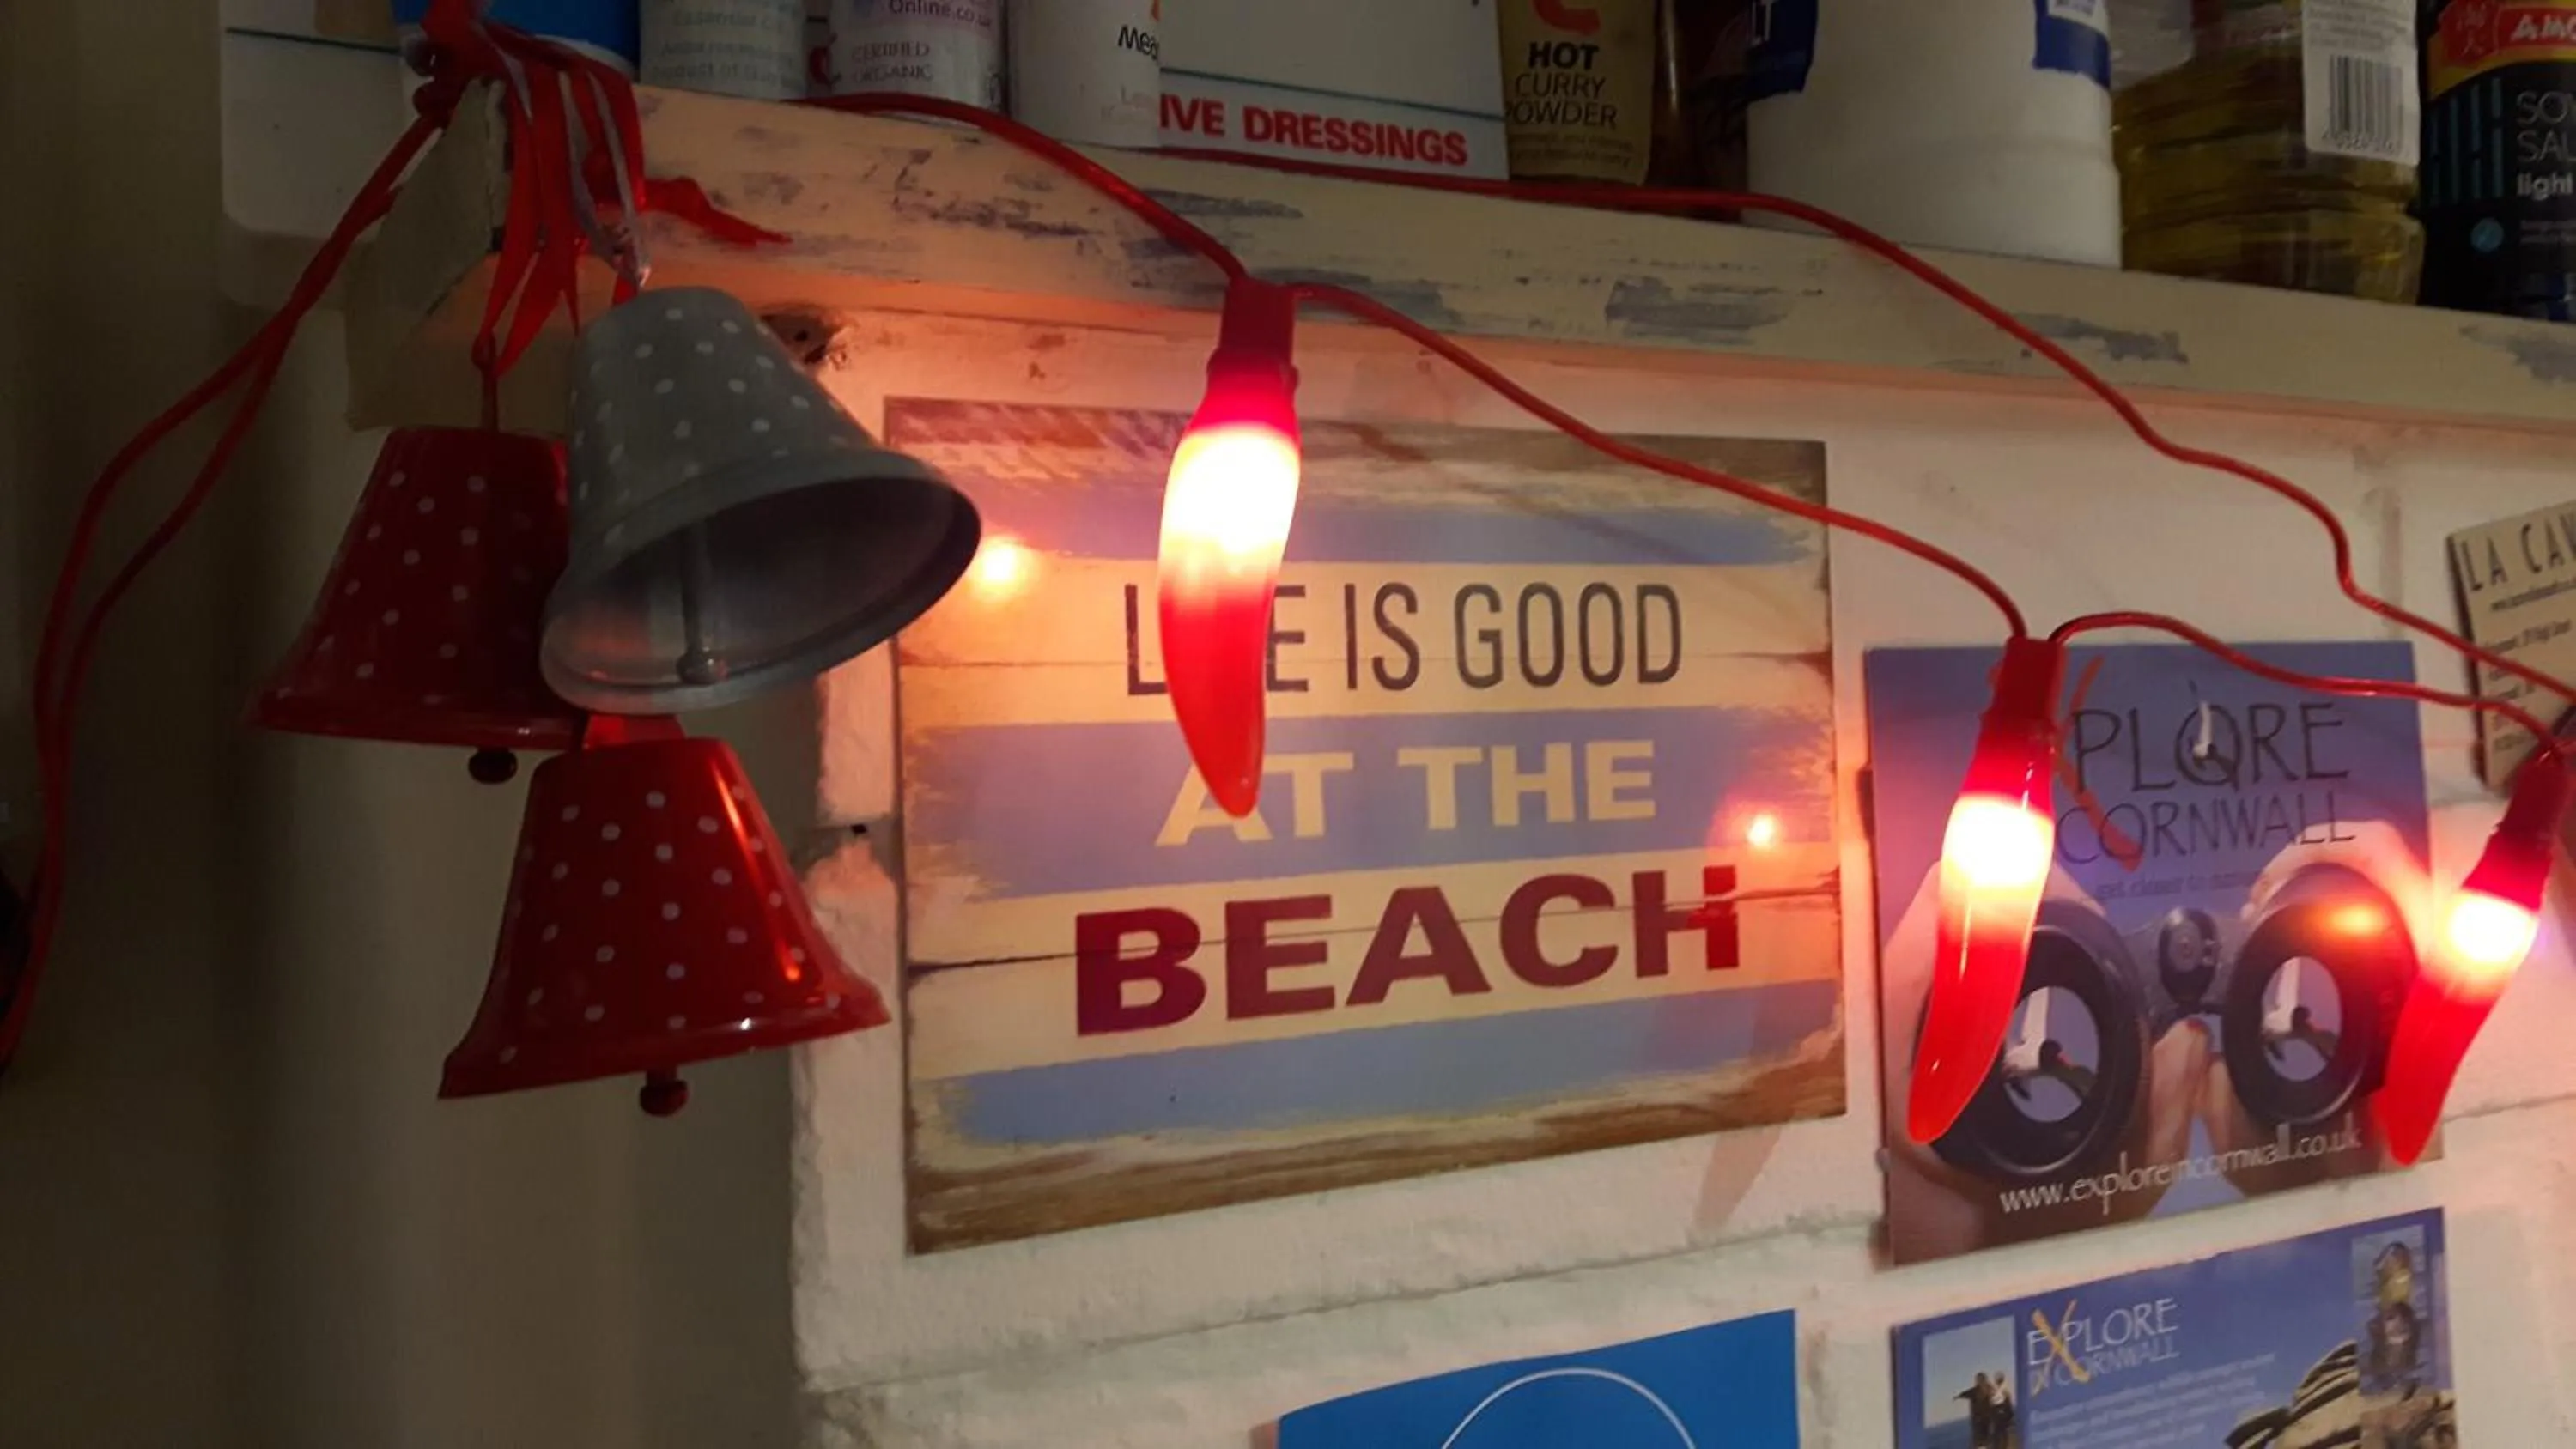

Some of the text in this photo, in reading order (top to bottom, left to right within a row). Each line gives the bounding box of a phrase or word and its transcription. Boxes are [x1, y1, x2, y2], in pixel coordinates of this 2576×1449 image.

[1516, 73, 1606, 99] CURRY
[1528, 41, 1600, 70] HOT
[1160, 94, 1225, 136] IVE
[1244, 106, 1467, 166] DRESSINGS
[2516, 88, 2575, 124] SO
[2516, 171, 2574, 201] light
[2460, 536, 2509, 591] LA
[1124, 580, 1682, 696] LE IS GOOD
[1155, 740, 1656, 848] AT THE
[2057, 791, 2357, 865] CORNWALL
[1076, 864, 1740, 1036] BEACH
[2027, 1297, 2179, 1367] EXPLORE
